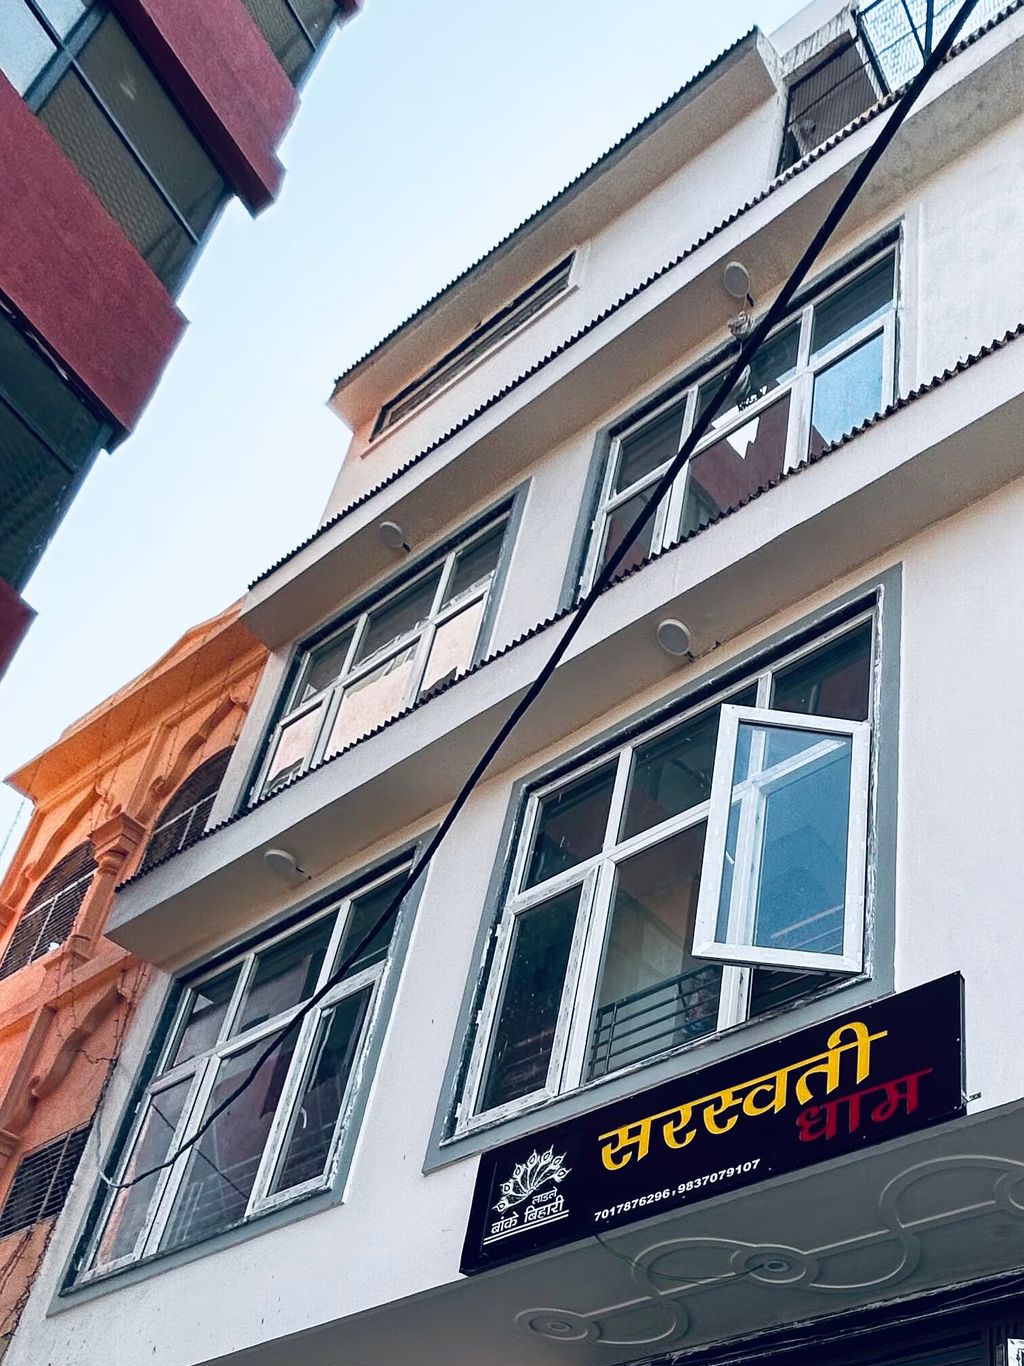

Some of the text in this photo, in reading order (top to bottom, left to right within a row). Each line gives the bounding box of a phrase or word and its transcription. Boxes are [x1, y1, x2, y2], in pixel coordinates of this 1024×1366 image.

[597, 1021, 888, 1171] सरस्वती
[796, 1067, 933, 1142] धाम
[491, 1194, 565, 1234] बांके बिहारी
[532, 1186, 558, 1205] लाडले
